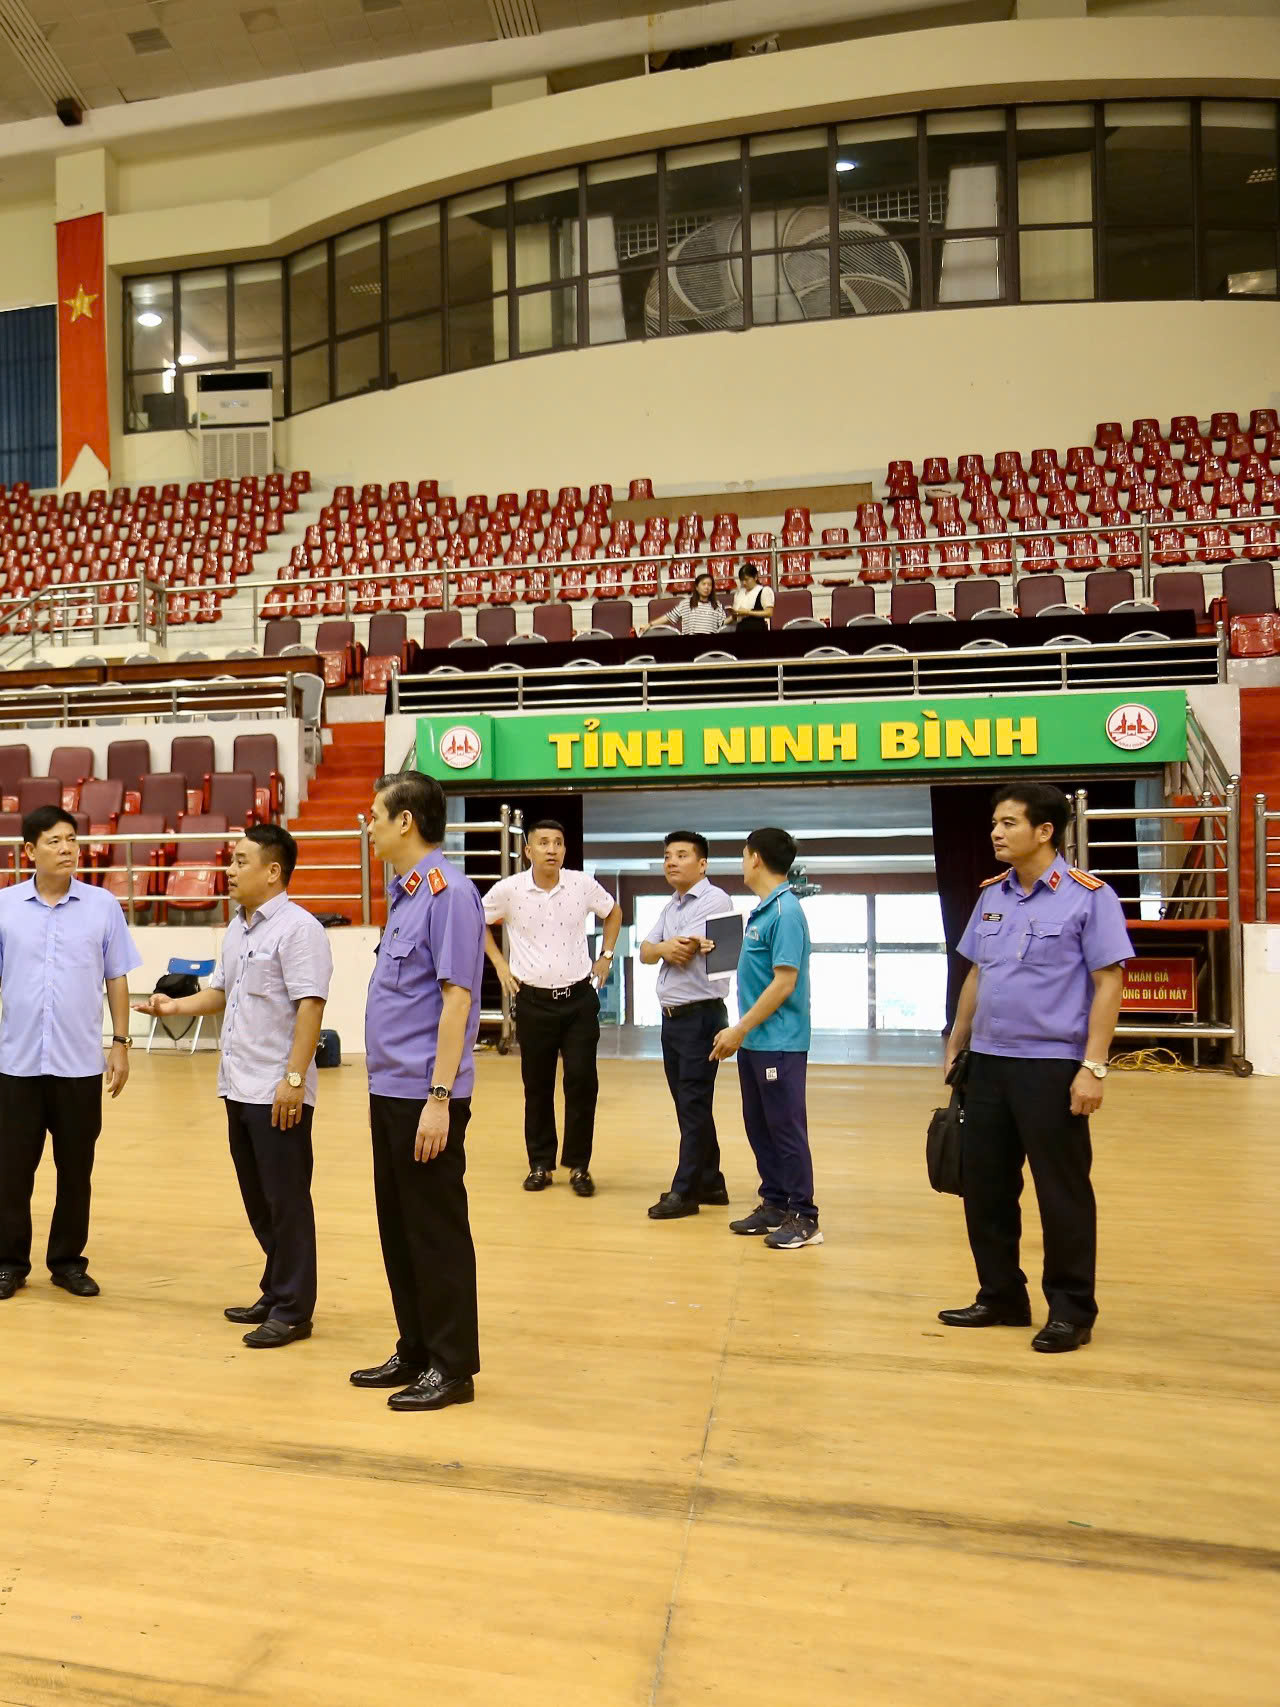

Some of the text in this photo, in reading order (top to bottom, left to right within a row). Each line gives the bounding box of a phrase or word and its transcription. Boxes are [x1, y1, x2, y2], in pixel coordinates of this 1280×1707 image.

[548, 709, 1038, 769] TỈNH NINH BÌNH
[1122, 986, 1140, 1000] ÔNG
